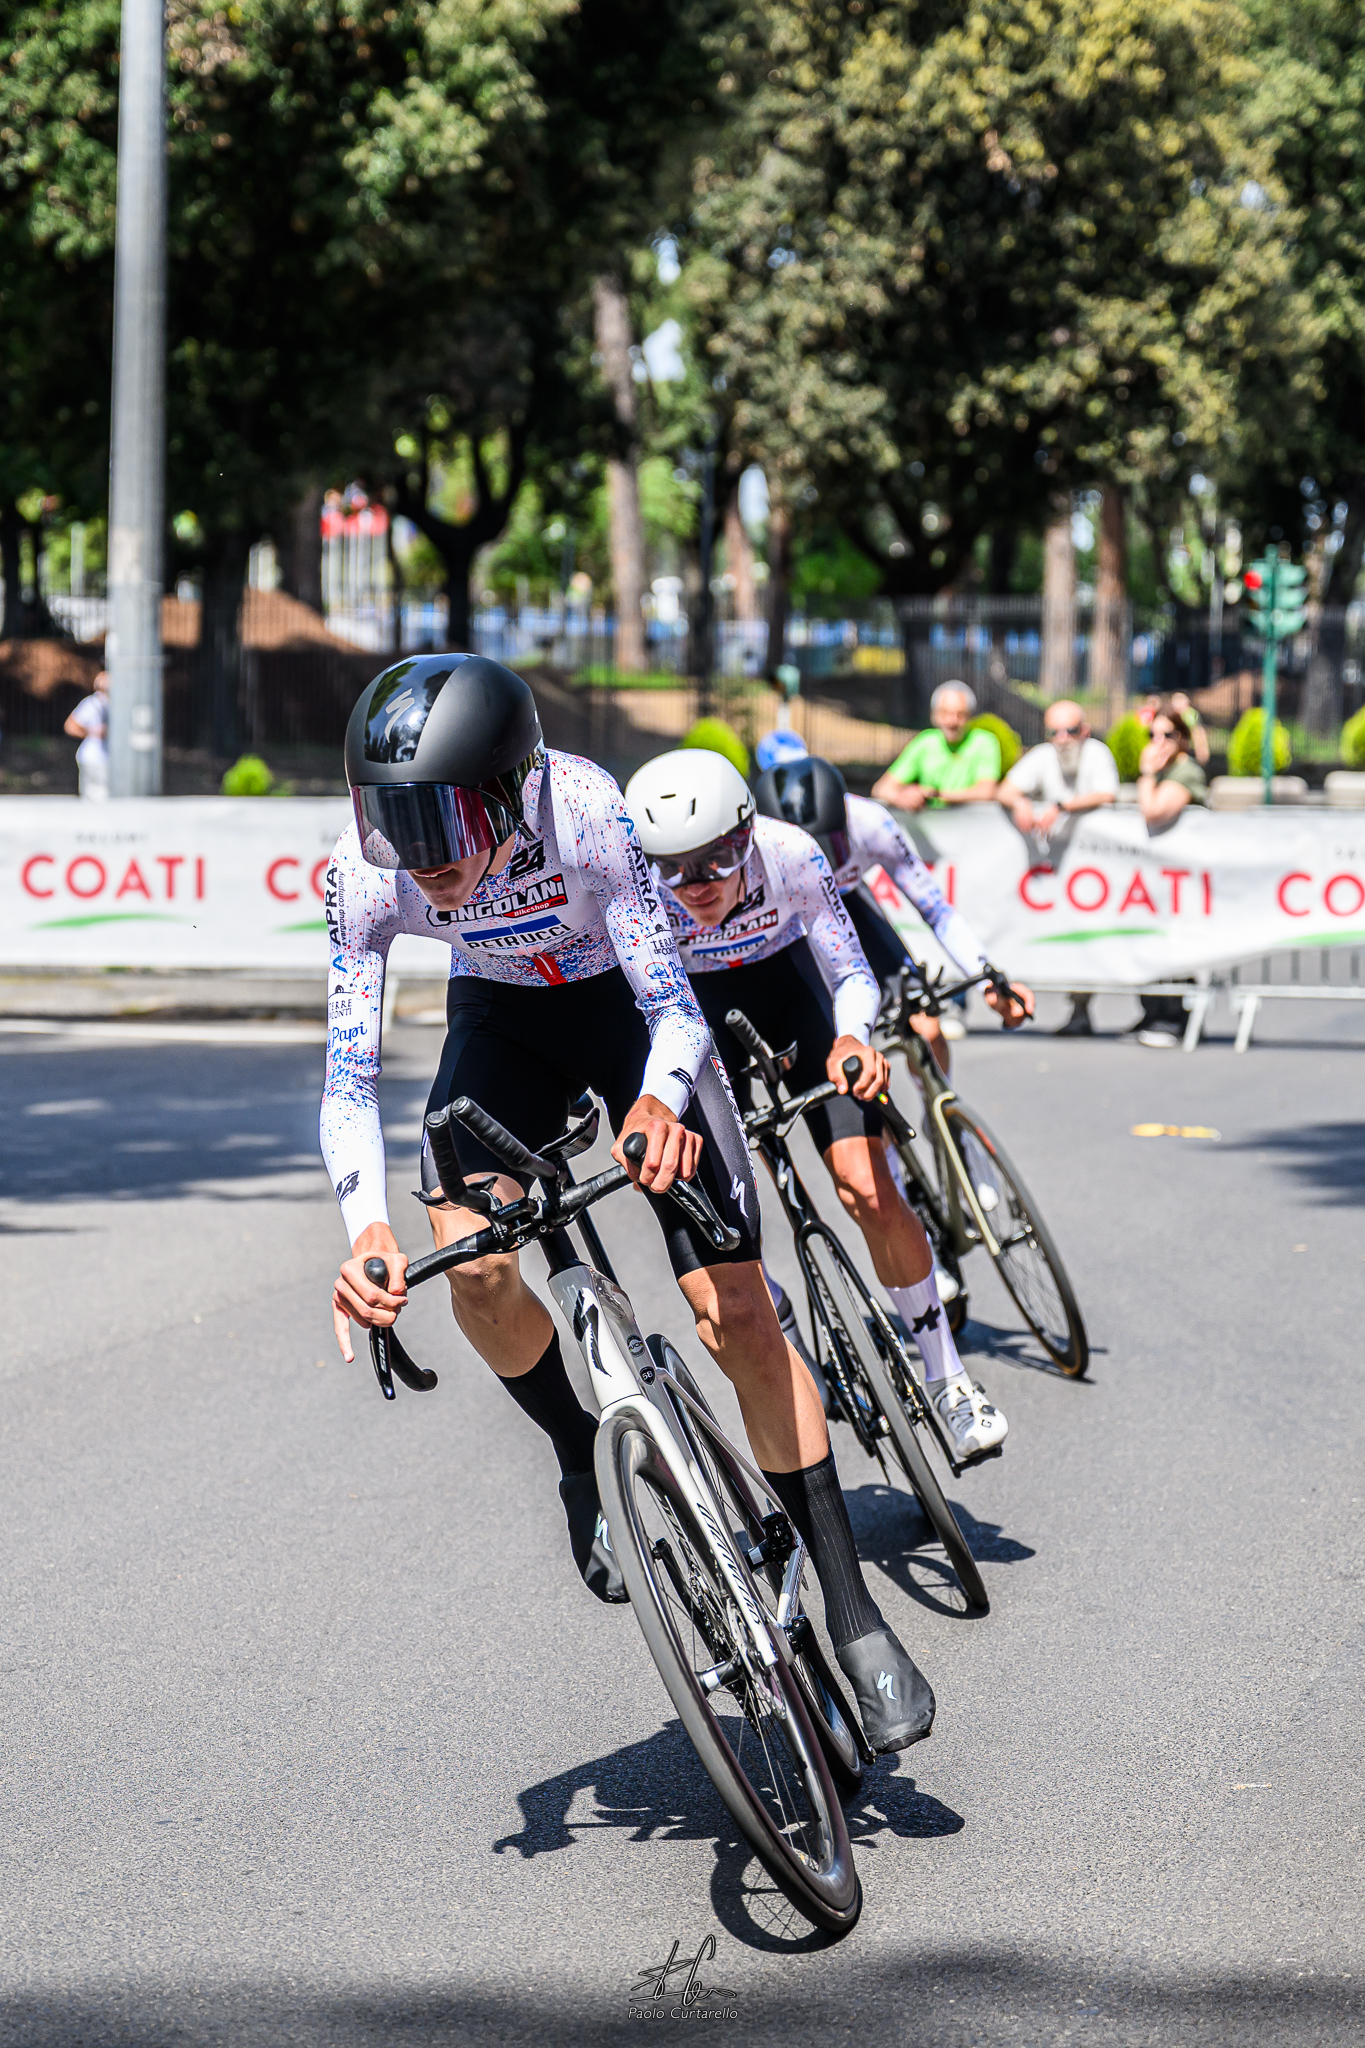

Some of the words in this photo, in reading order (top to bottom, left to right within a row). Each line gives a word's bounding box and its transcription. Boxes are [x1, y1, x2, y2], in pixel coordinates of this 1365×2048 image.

[20, 854, 206, 901] COATI
[631, 845, 658, 917] APRA
[1018, 862, 1213, 917] COATI
[326, 868, 341, 946] APRA
[466, 923, 572, 949] PETRUCCI
[332, 1021, 367, 1048] Papi
[497, 1203, 519, 1215] GARMIN
